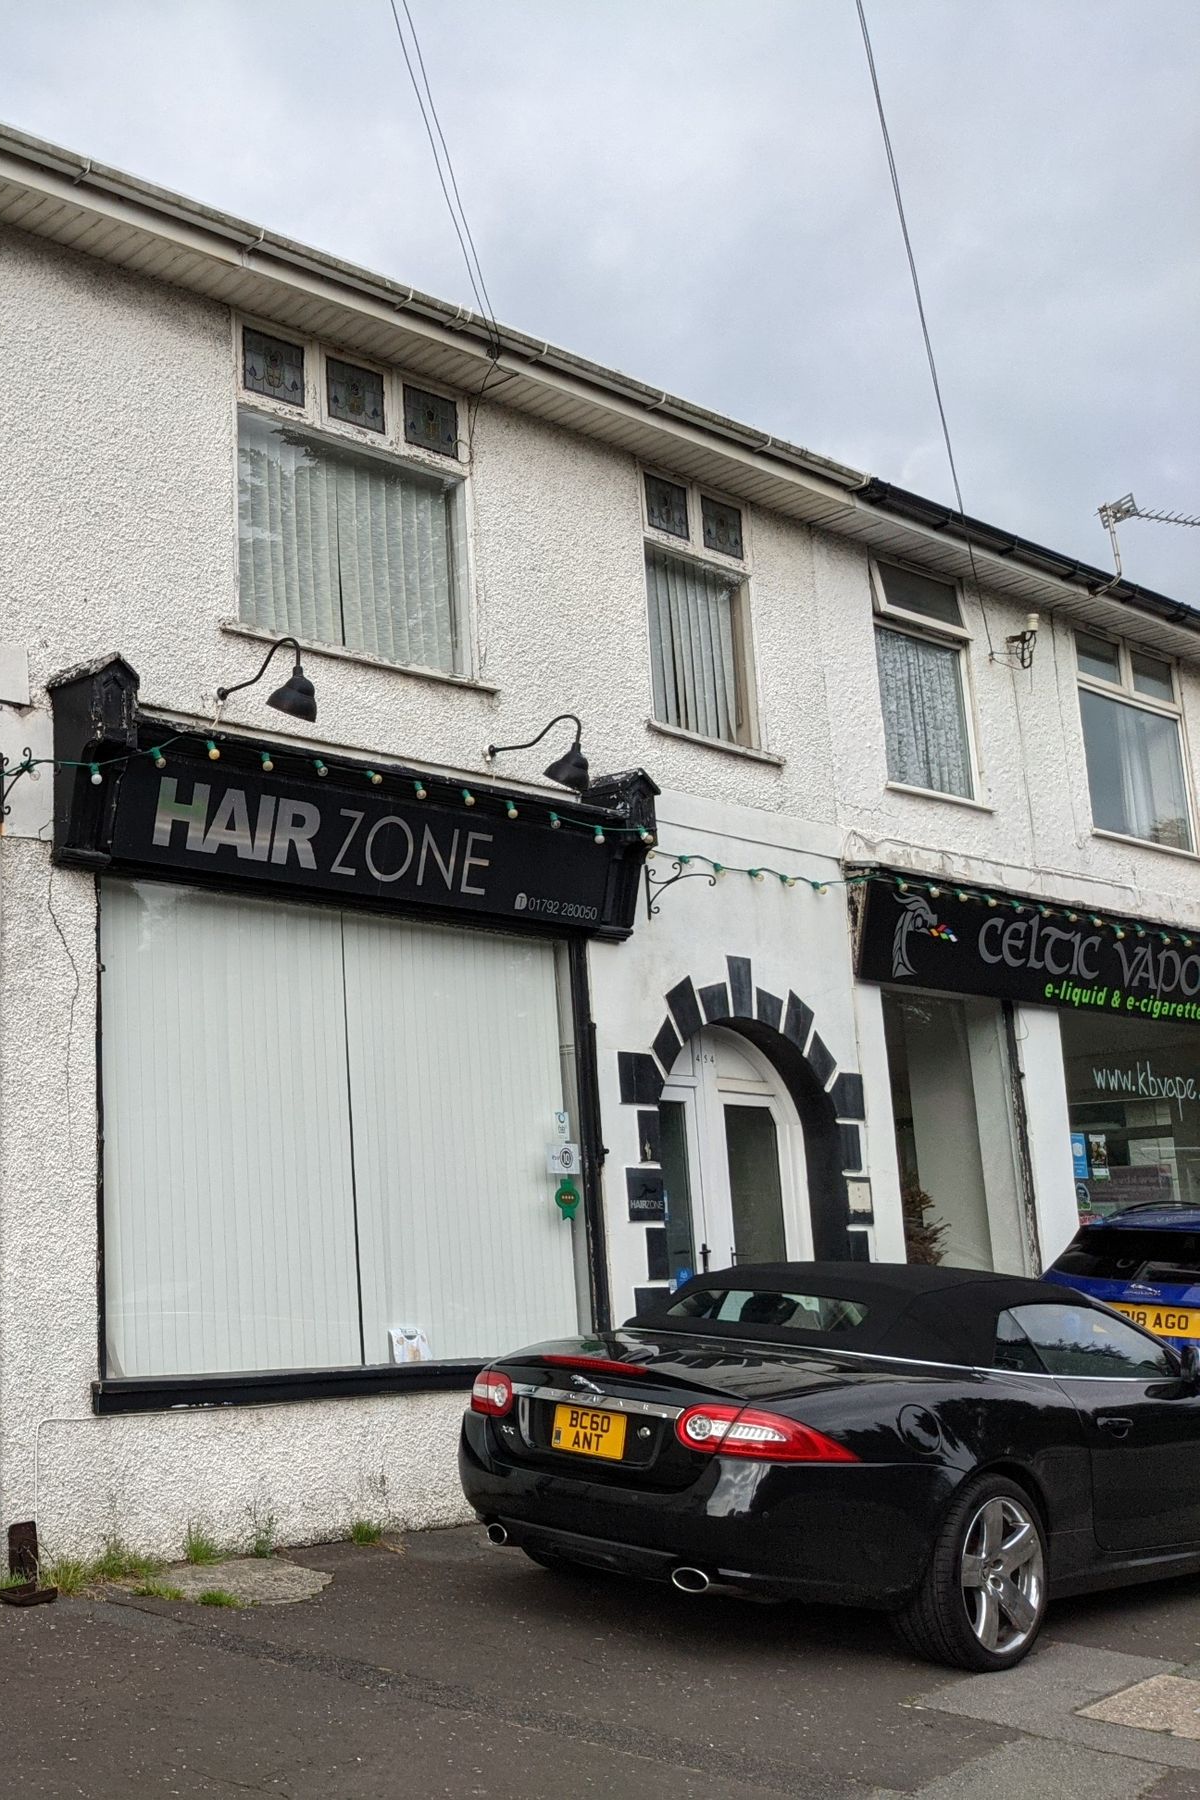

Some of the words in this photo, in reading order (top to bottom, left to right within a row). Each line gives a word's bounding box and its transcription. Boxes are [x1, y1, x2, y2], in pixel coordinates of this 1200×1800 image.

[152, 776, 321, 870] HAIR
[330, 808, 493, 896] ZONE
[528, 897, 560, 915] 01792
[561, 902, 598, 920] 280050
[1044, 980, 1107, 1007] e-liquid
[1111, 989, 1121, 1008] &
[1152, 1312, 1189, 1330] AGO
[568, 1410, 611, 1433] BC60
[571, 1431, 604, 1452] ANT
